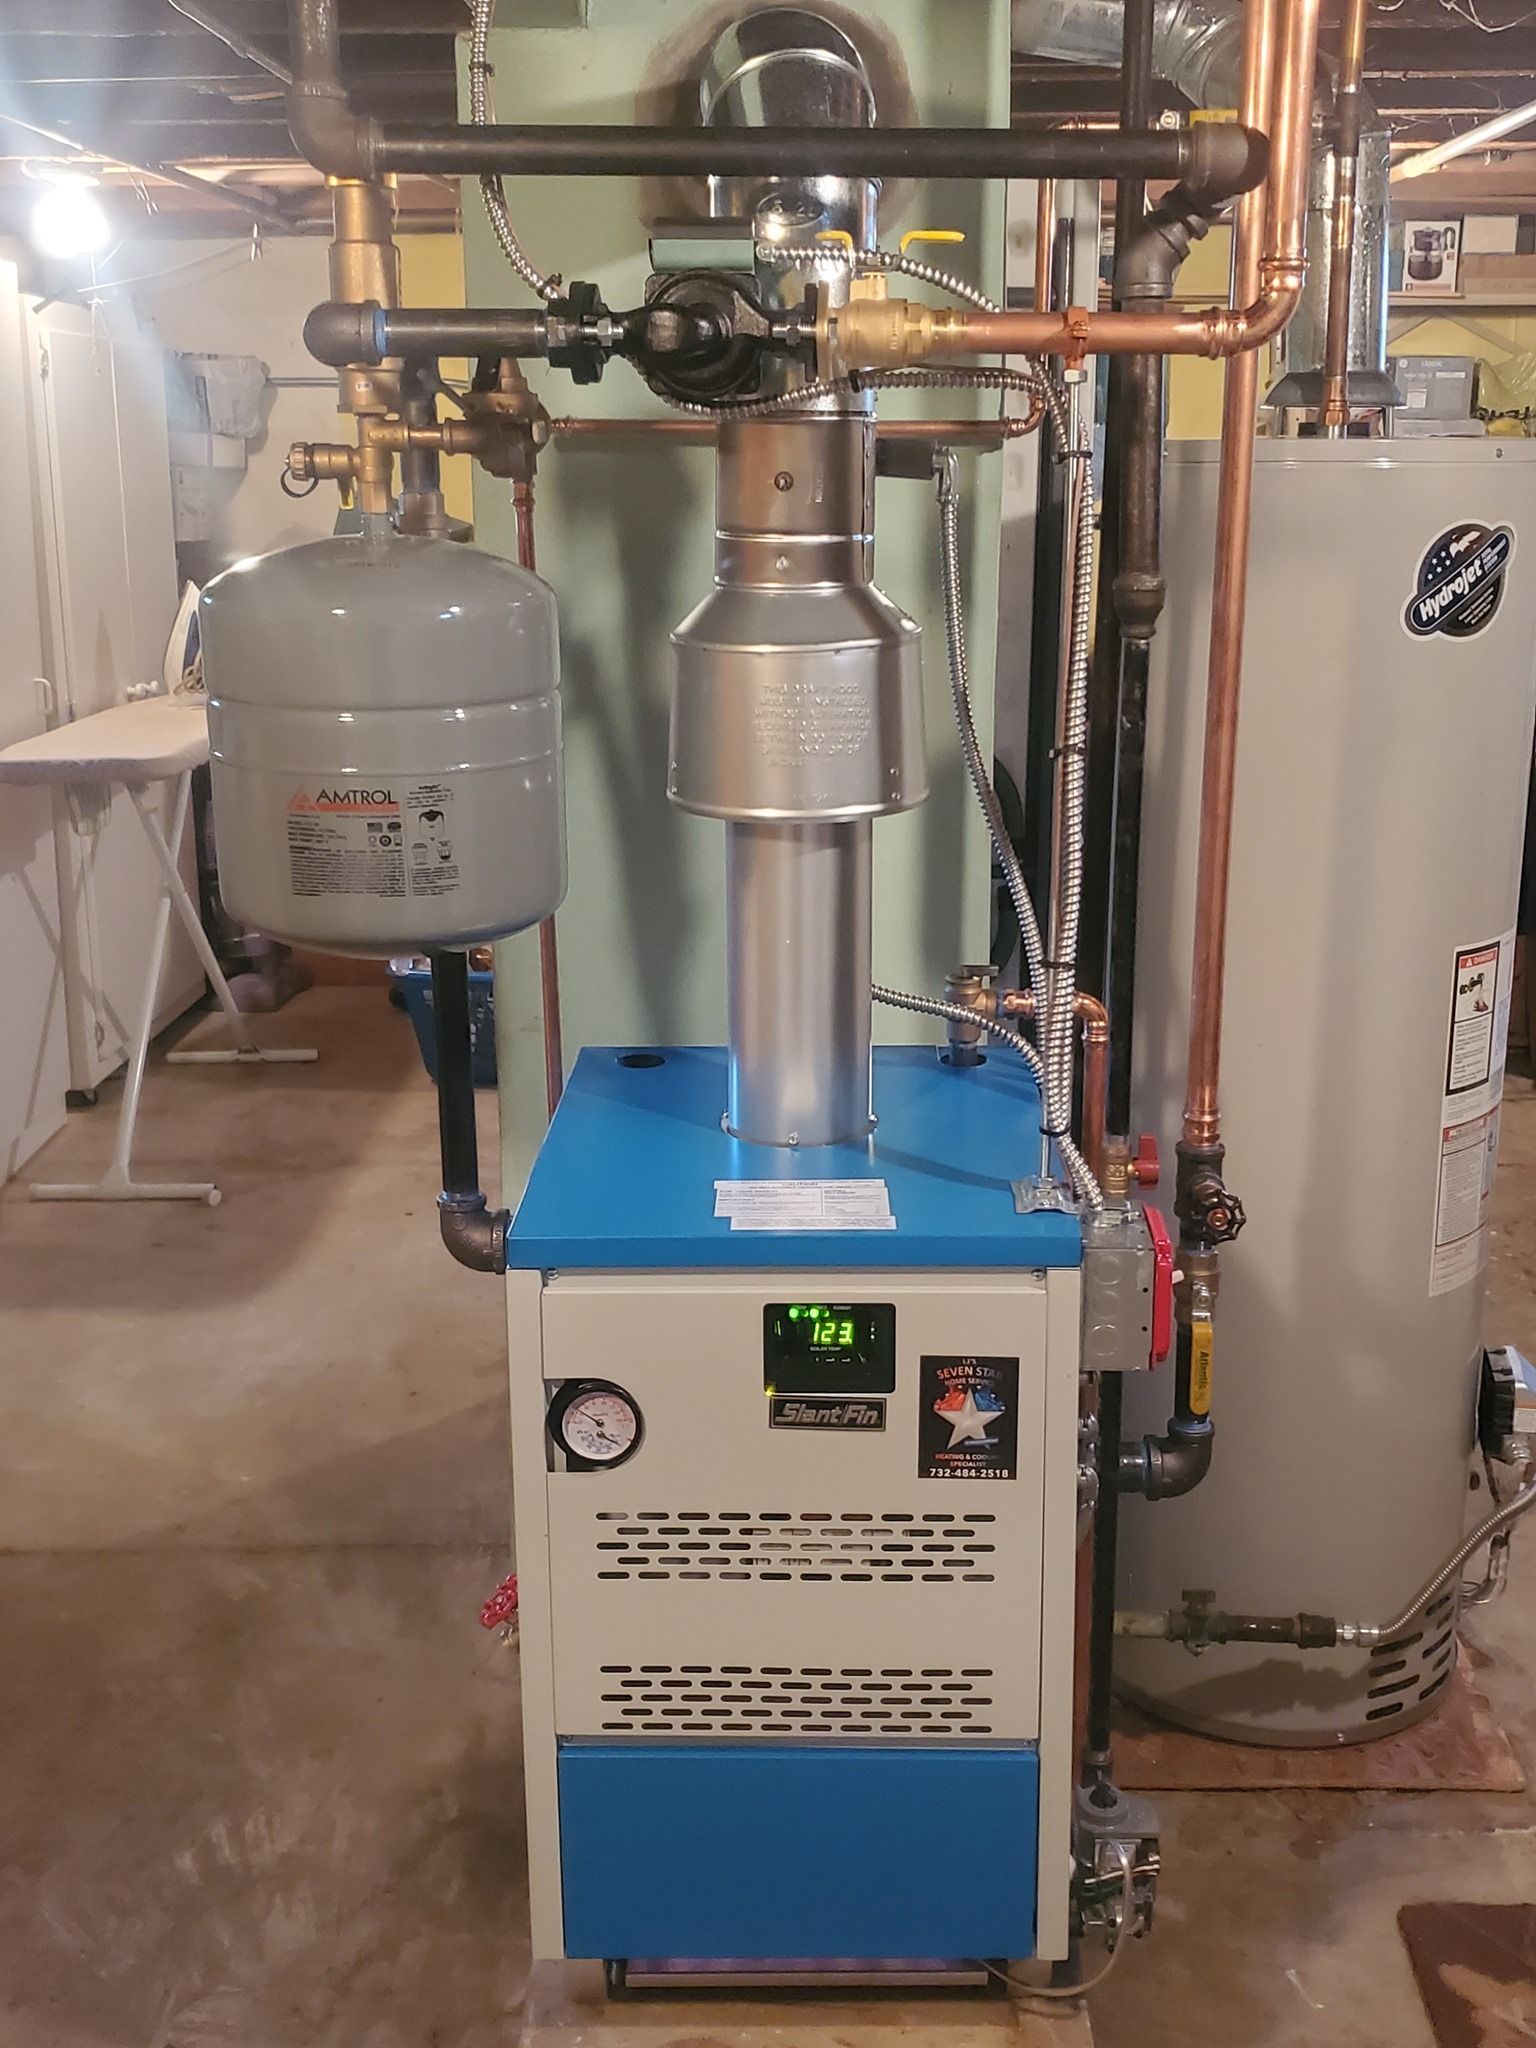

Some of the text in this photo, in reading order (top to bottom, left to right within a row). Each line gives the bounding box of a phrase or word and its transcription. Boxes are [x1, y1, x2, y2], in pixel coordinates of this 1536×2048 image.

[1418, 558, 1483, 623] Hydrojet
[316, 789, 399, 805] AMTROL
[936, 1366, 974, 1380] SEVEN
[929, 1468, 1009, 1478] 732-484-2518
